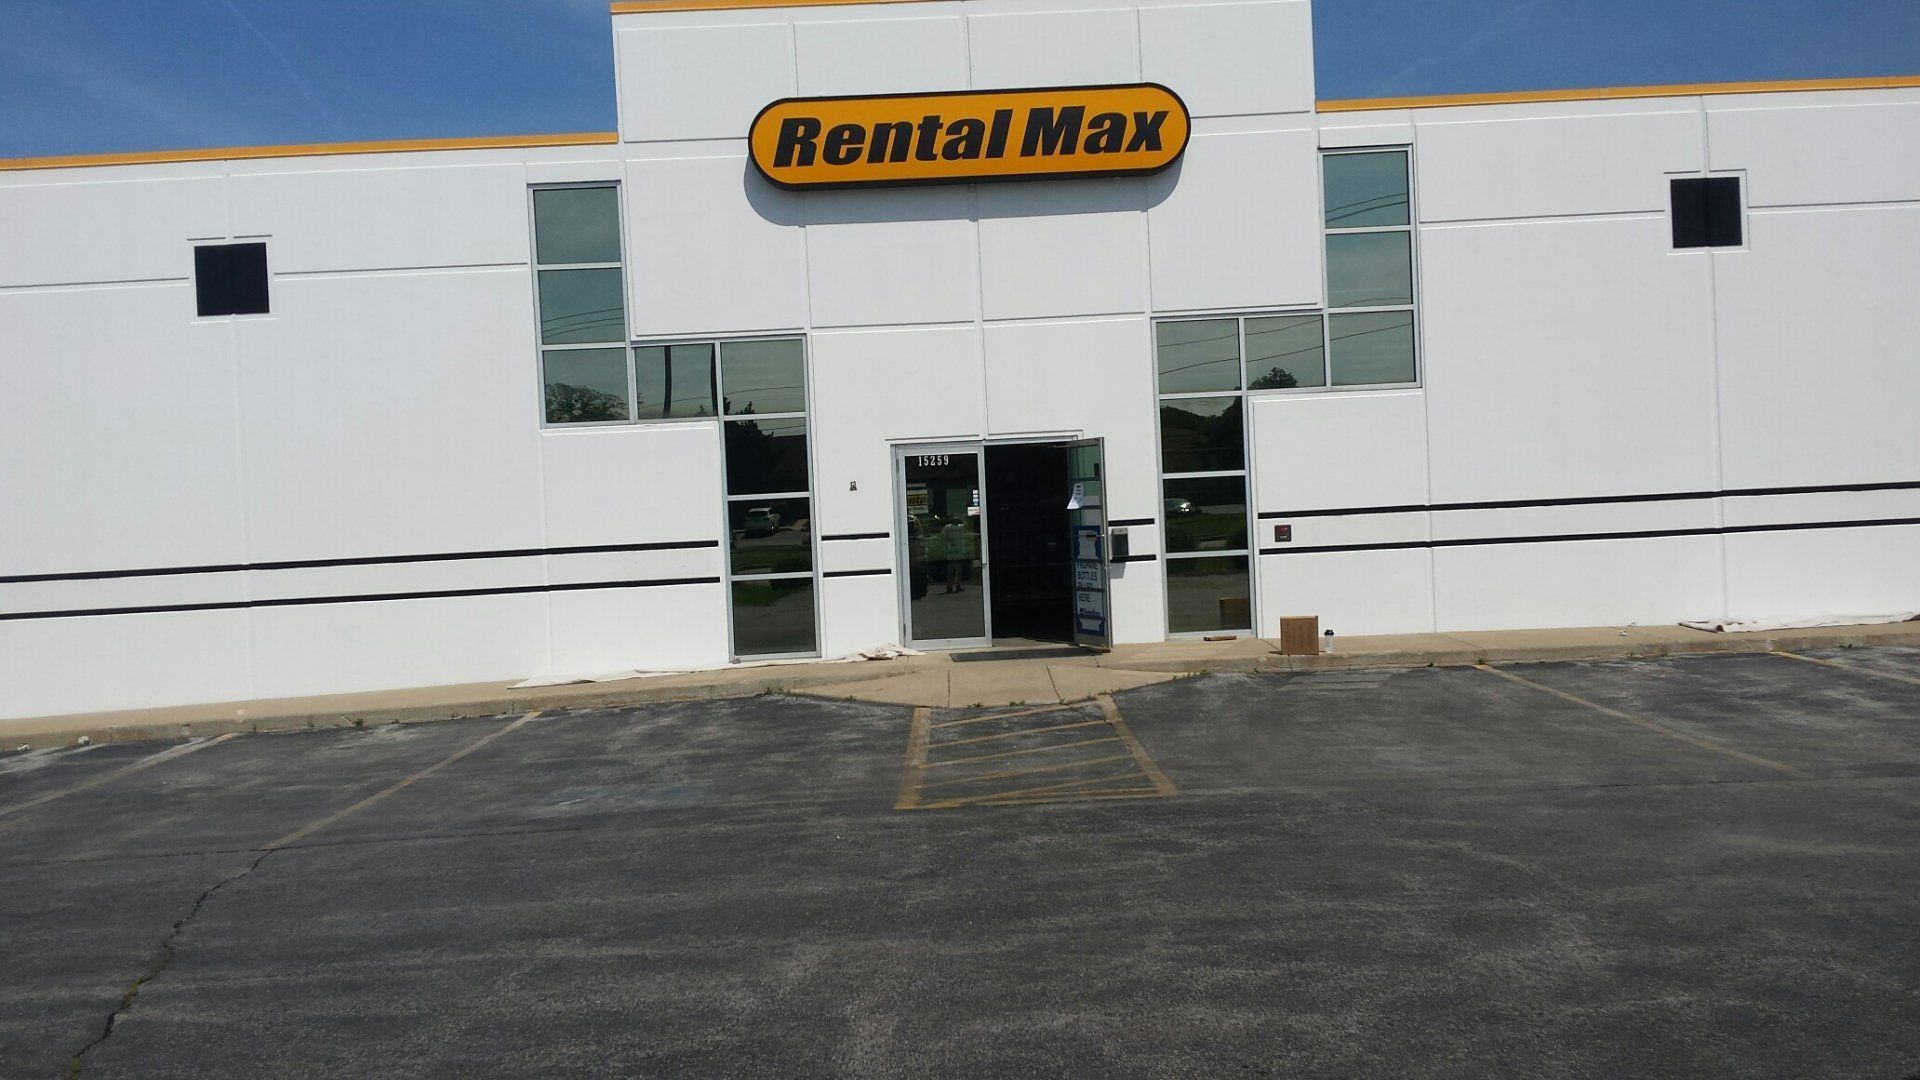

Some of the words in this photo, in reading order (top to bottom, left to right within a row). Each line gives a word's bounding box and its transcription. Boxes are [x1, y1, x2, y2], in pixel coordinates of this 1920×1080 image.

[772, 109, 1013, 168] Rental
[1019, 106, 1170, 158] Max
[918, 455, 949, 467] 15259
